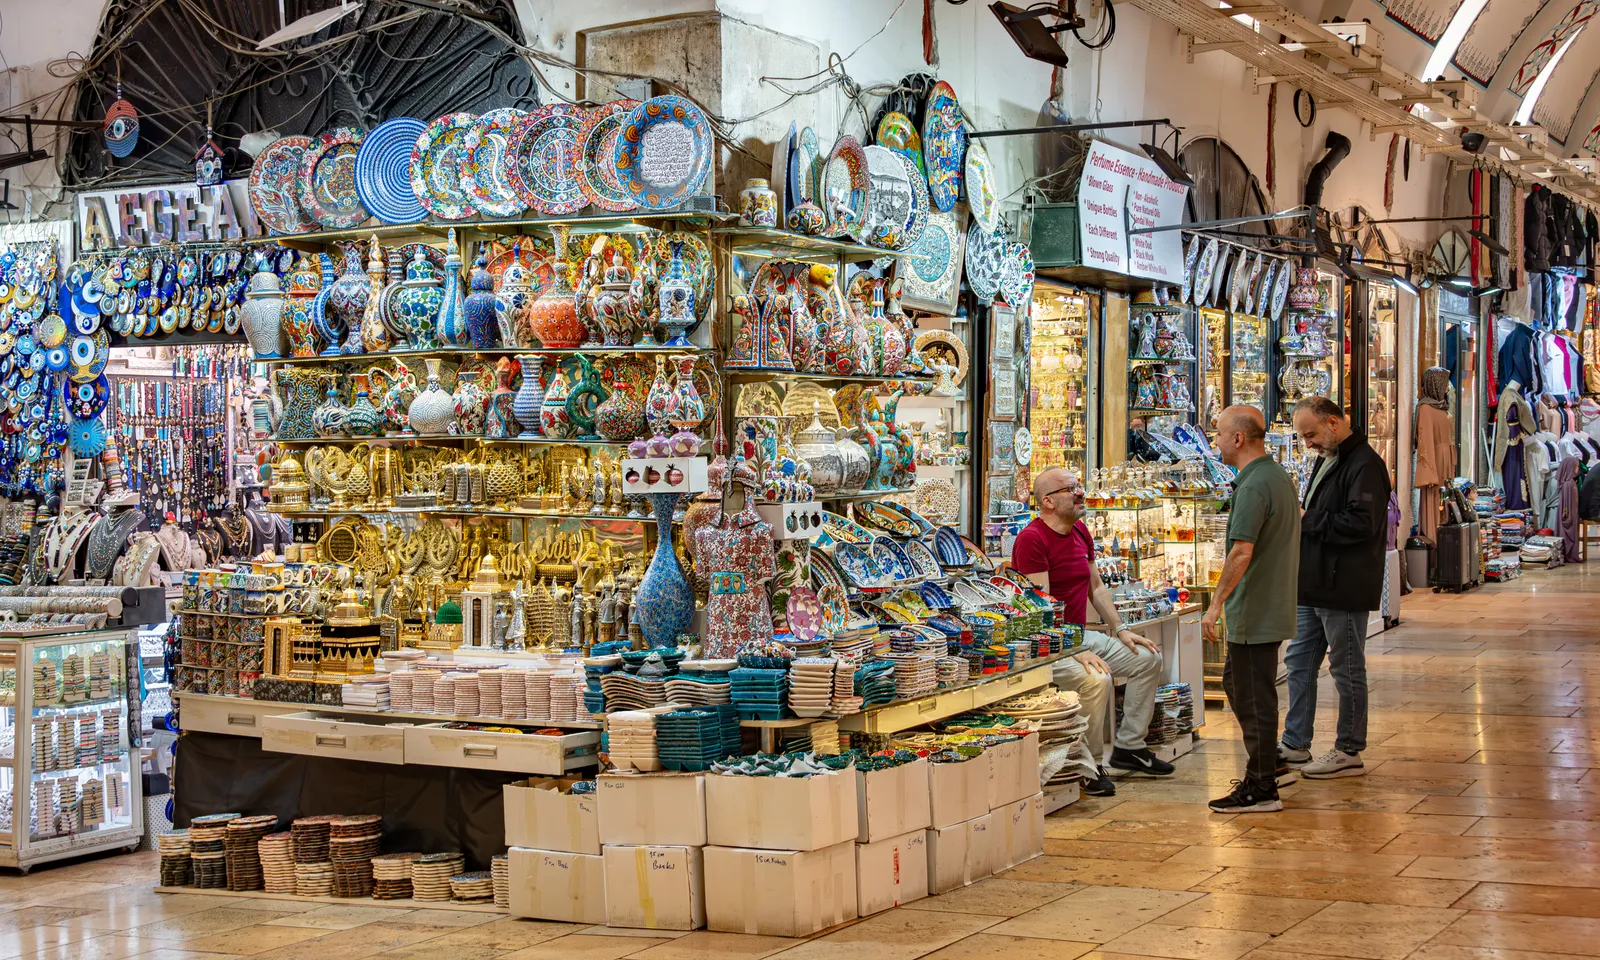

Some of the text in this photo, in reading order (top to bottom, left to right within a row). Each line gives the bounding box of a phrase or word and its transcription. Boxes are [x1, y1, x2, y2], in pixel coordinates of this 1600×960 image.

[1090, 151, 1114, 171] Perfume
[1114, 159, 1135, 178] Essence
[1137, 167, 1164, 188] Handmade
[1088, 175, 1113, 192] Blown Glass
[1103, 204, 1117, 217] Bottles
[1088, 223, 1117, 240] Each Different
[1135, 238, 1145, 248] White
[1090, 247, 1119, 265] Strong Quality
